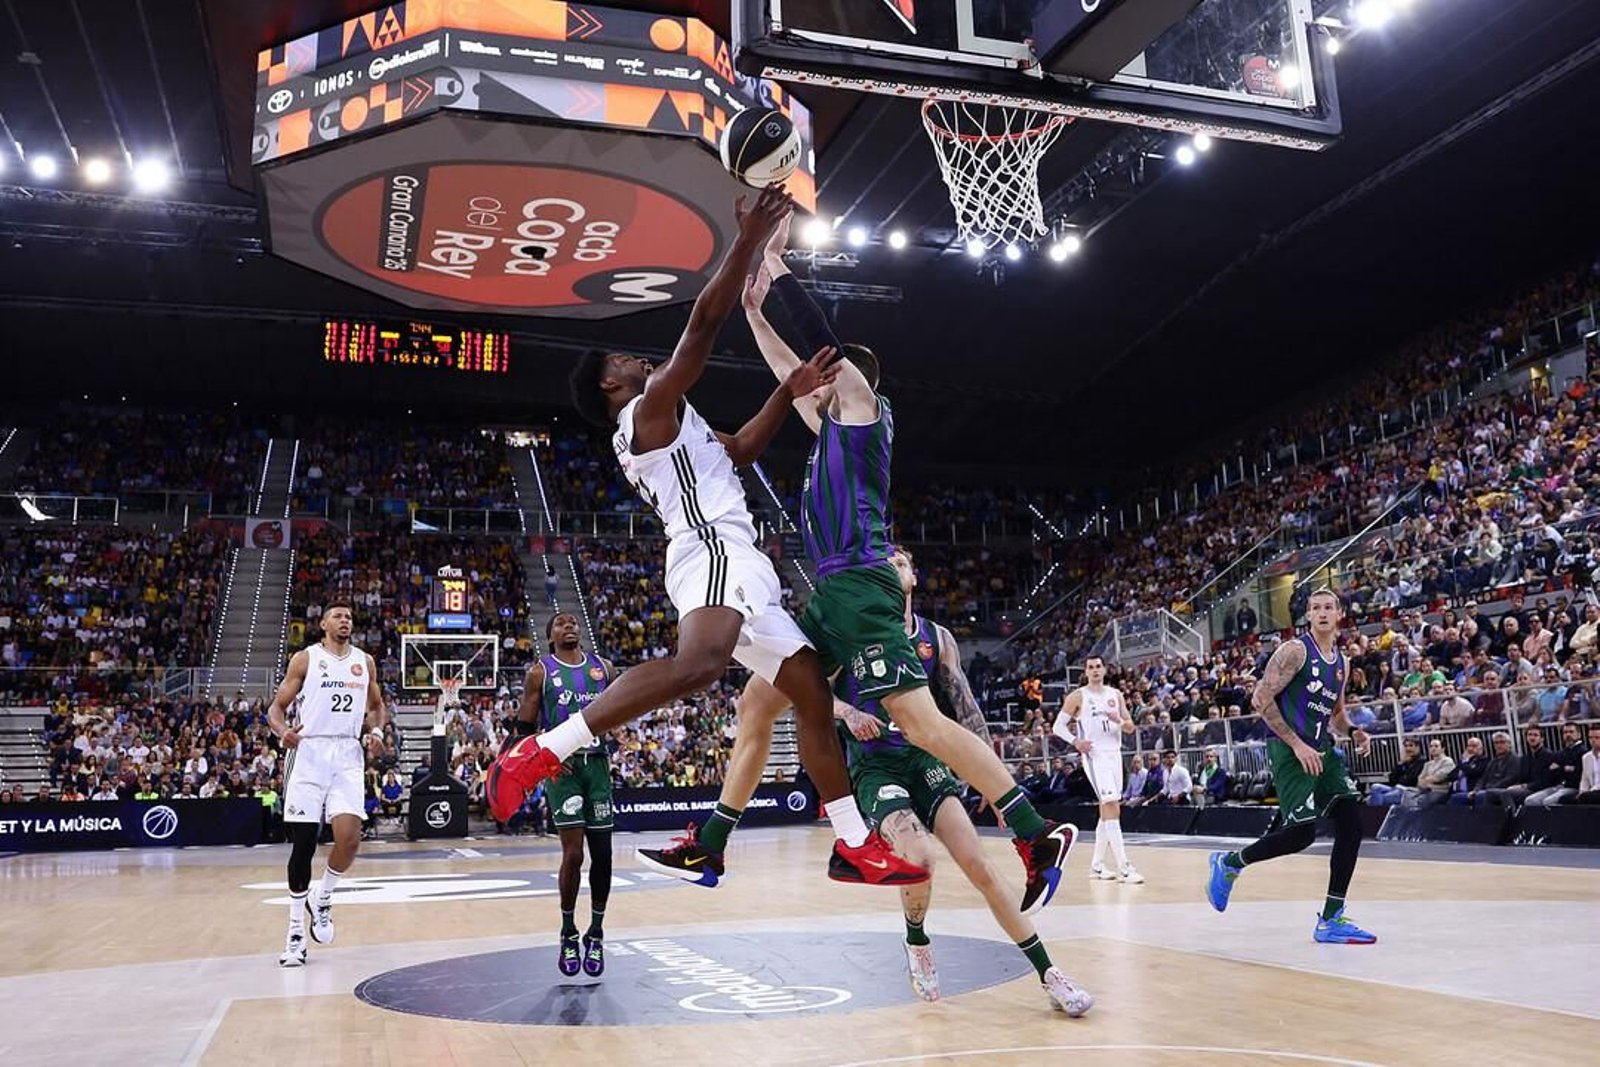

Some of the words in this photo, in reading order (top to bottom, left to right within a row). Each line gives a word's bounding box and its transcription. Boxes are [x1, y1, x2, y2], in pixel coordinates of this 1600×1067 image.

[314, 70, 353, 97] IONOS
[390, 175, 419, 210] Gran
[466, 196, 507, 232] del
[386, 212, 415, 257] Canaria
[501, 197, 586, 276] Copa
[573, 221, 620, 261] acb
[417, 229, 495, 279] Rey
[445, 592, 463, 611] 18
[331, 694, 353, 712] 22
[1314, 720, 1322, 740] 1
[0, 820, 18, 833] ET
[21, 819, 33, 833] Y
[35, 819, 56, 833] LA
[60, 815, 122, 832] MÚSICA
